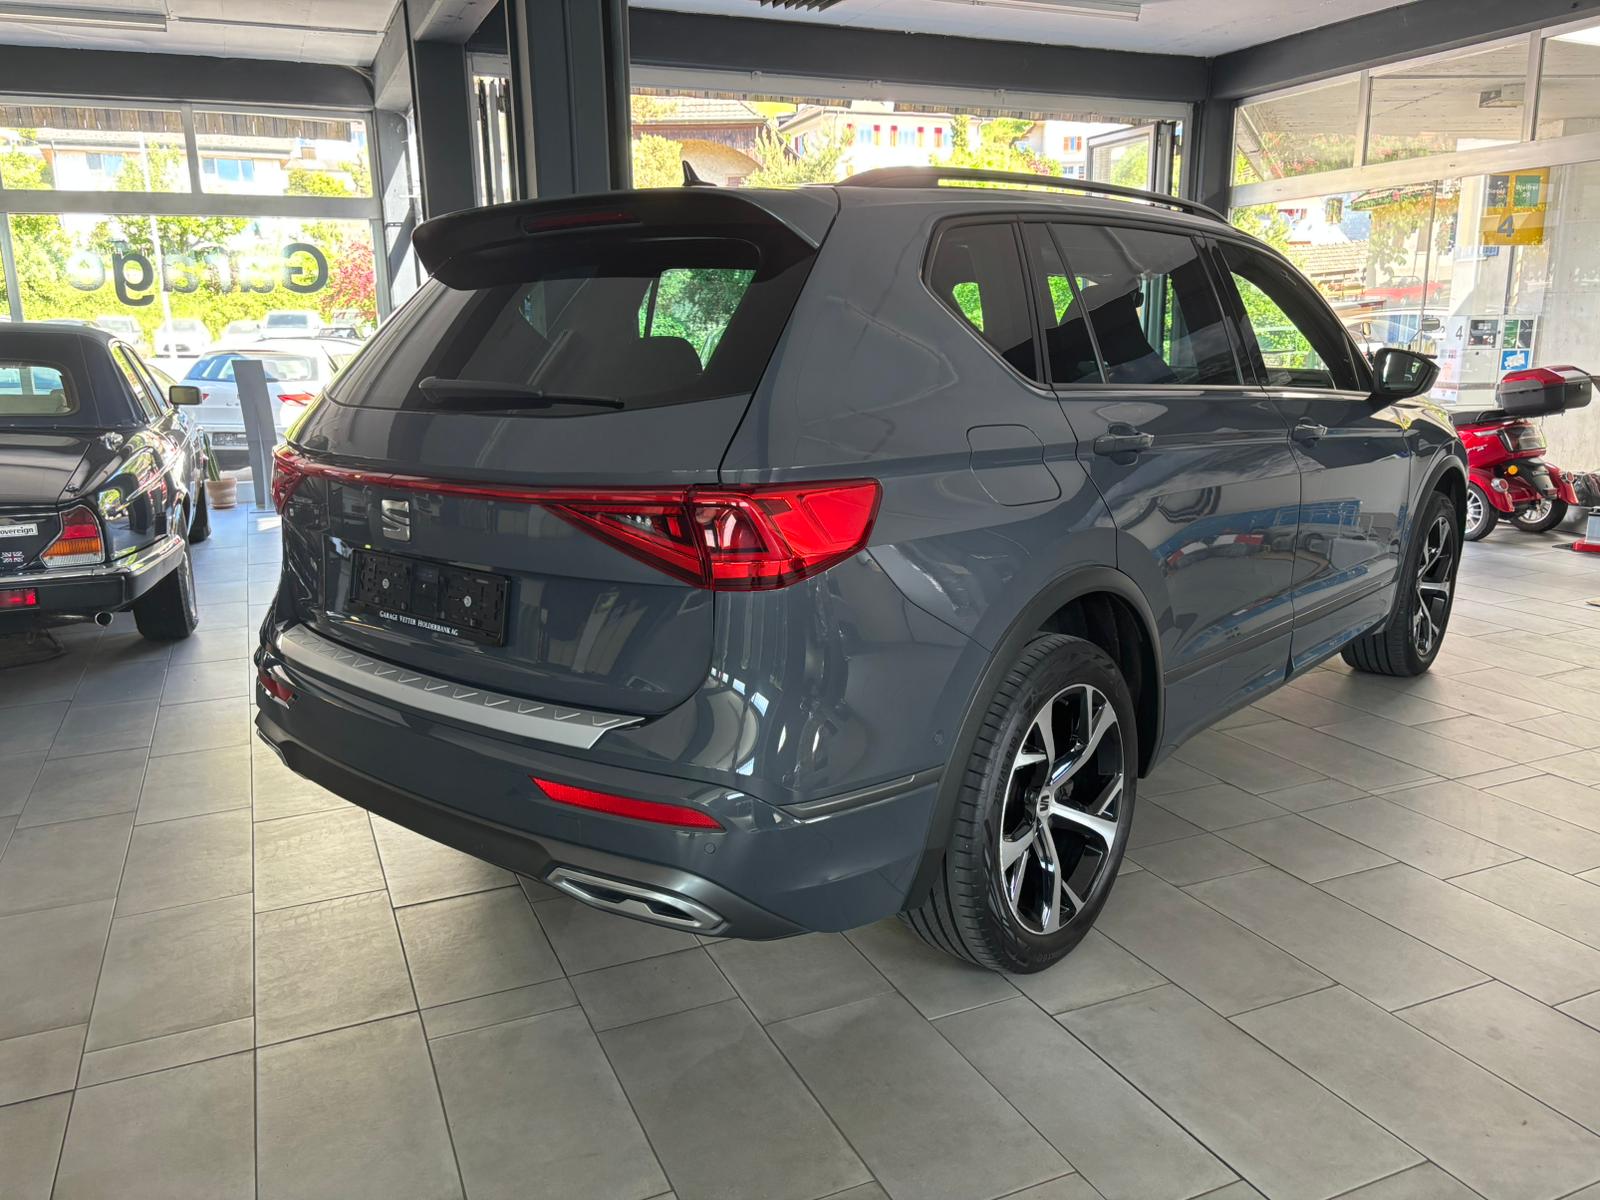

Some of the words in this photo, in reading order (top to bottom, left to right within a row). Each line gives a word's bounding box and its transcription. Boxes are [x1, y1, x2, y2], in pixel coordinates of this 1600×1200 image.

[1497, 215, 1514, 237] 4
[0, 526, 34, 536] overeign
[379, 610, 398, 621] GARAGE
[417, 619, 450, 633] HOLDERBANK
[450, 628, 459, 636] AG
